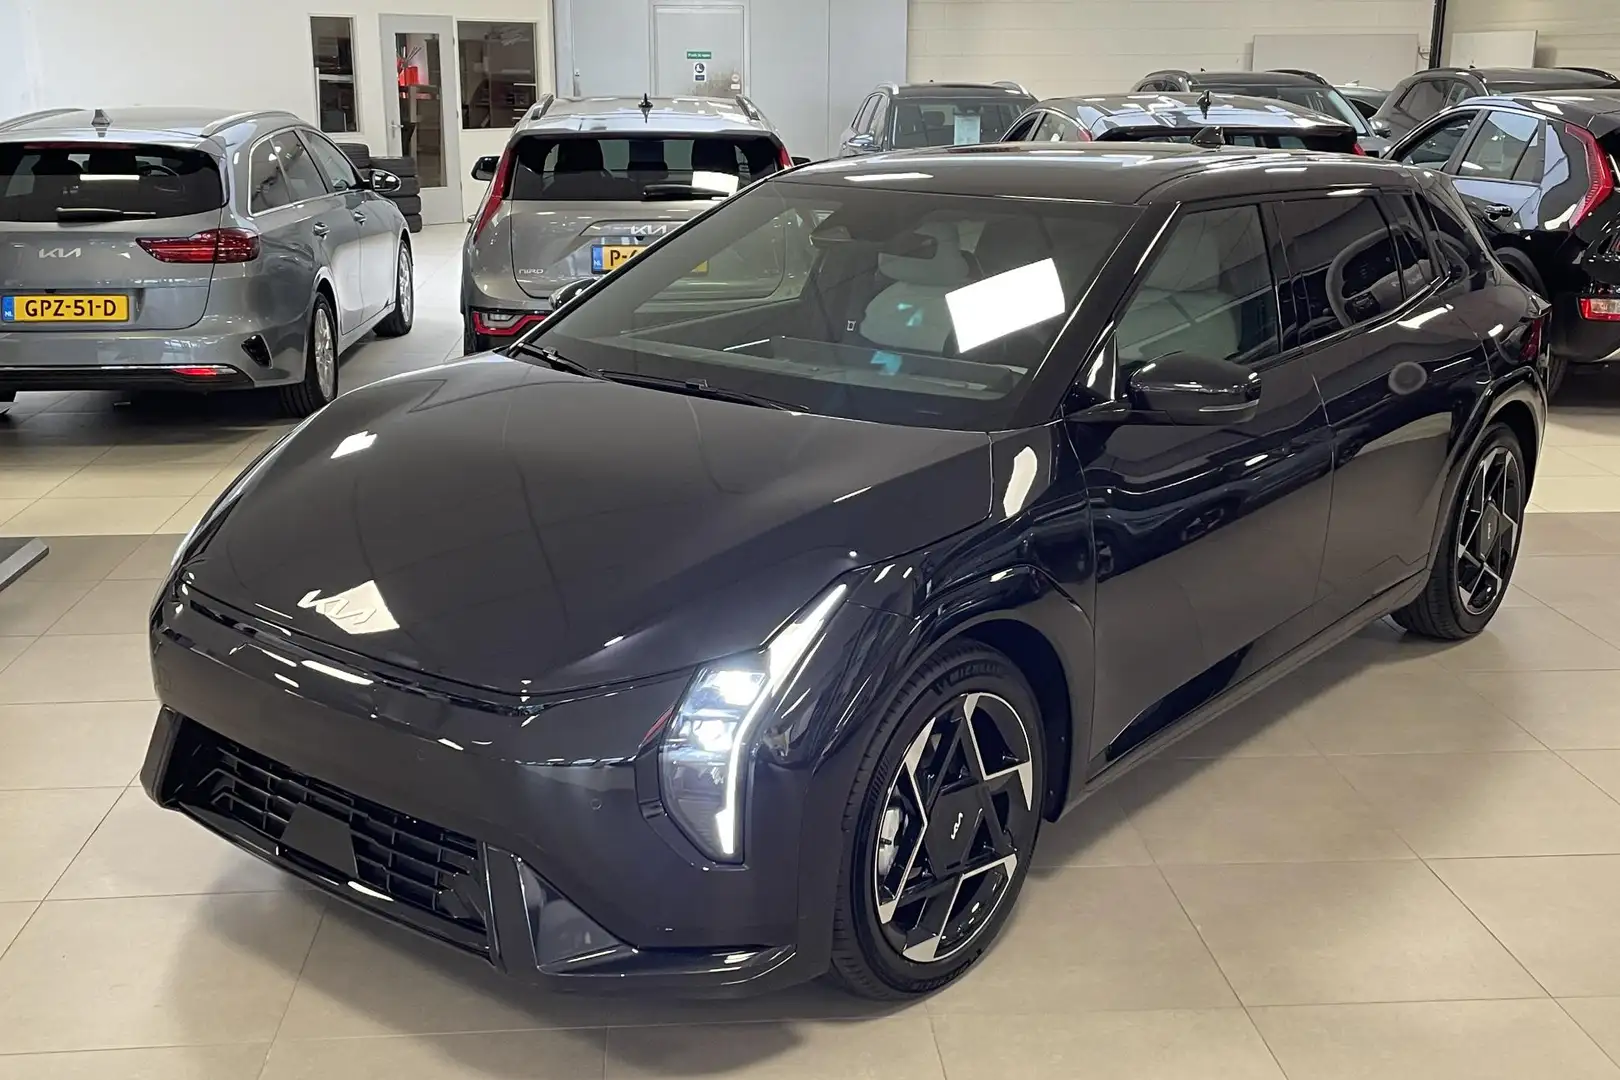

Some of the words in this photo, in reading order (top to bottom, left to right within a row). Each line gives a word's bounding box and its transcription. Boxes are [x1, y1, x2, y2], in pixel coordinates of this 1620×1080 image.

[630, 225, 667, 235] KIA
[38, 247, 82, 258] KIA
[25, 299, 117, 317] GPZ-51-D
